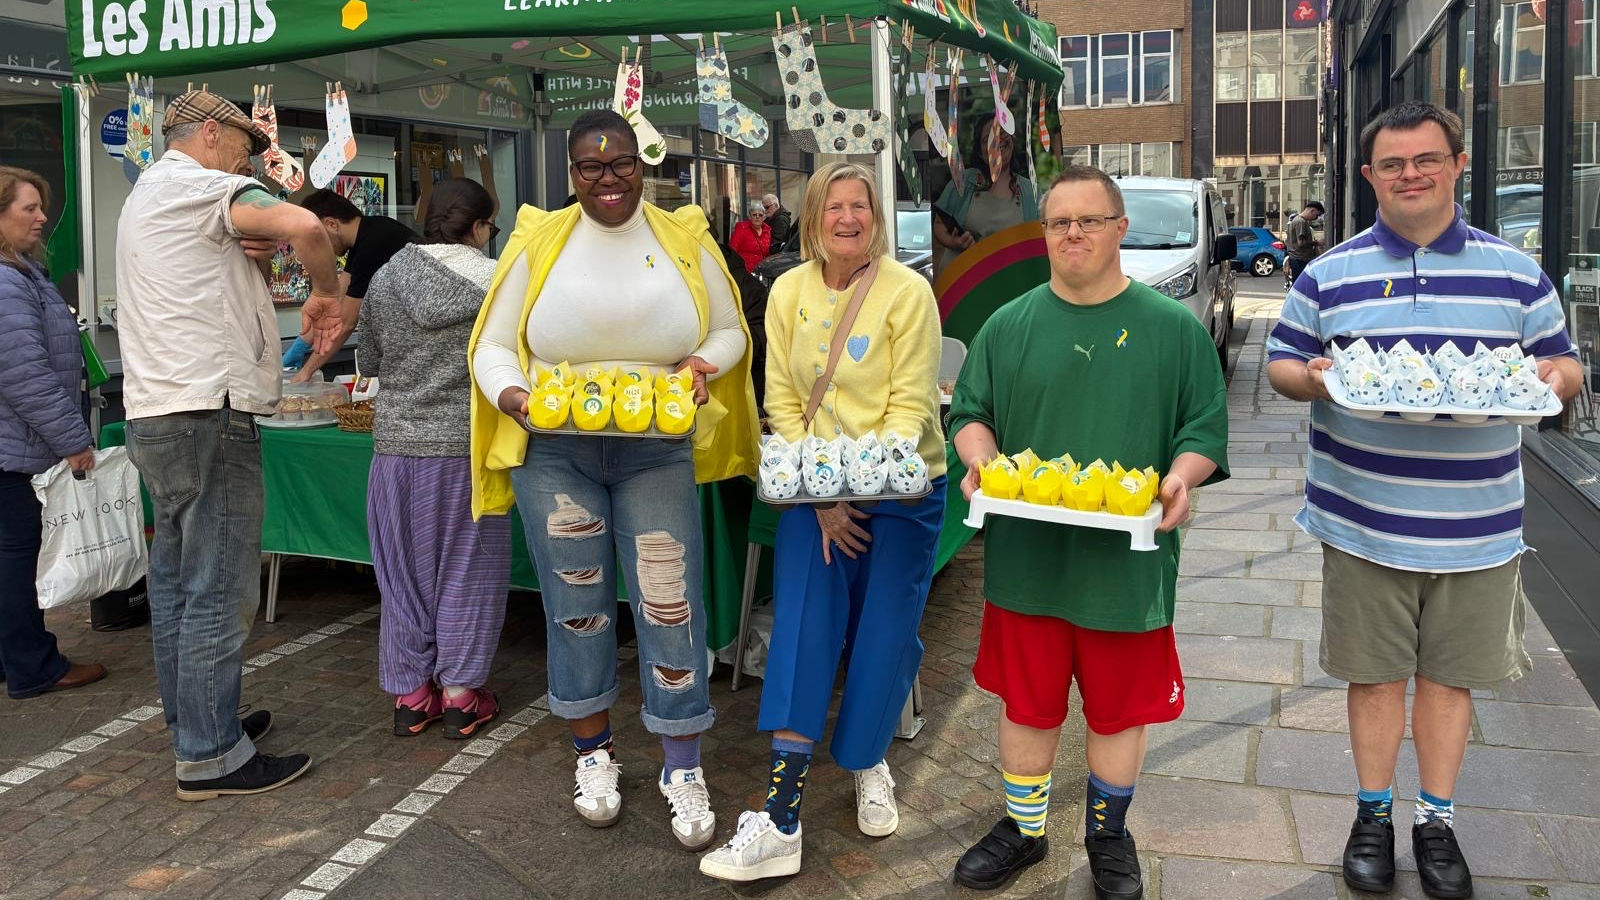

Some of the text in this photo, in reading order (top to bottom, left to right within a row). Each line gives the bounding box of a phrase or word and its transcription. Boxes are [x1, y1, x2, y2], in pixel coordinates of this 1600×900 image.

[82, 0, 277, 58] Les Amis
[108, 115, 124, 125] 0%
[46, 510, 86, 529] NEW
